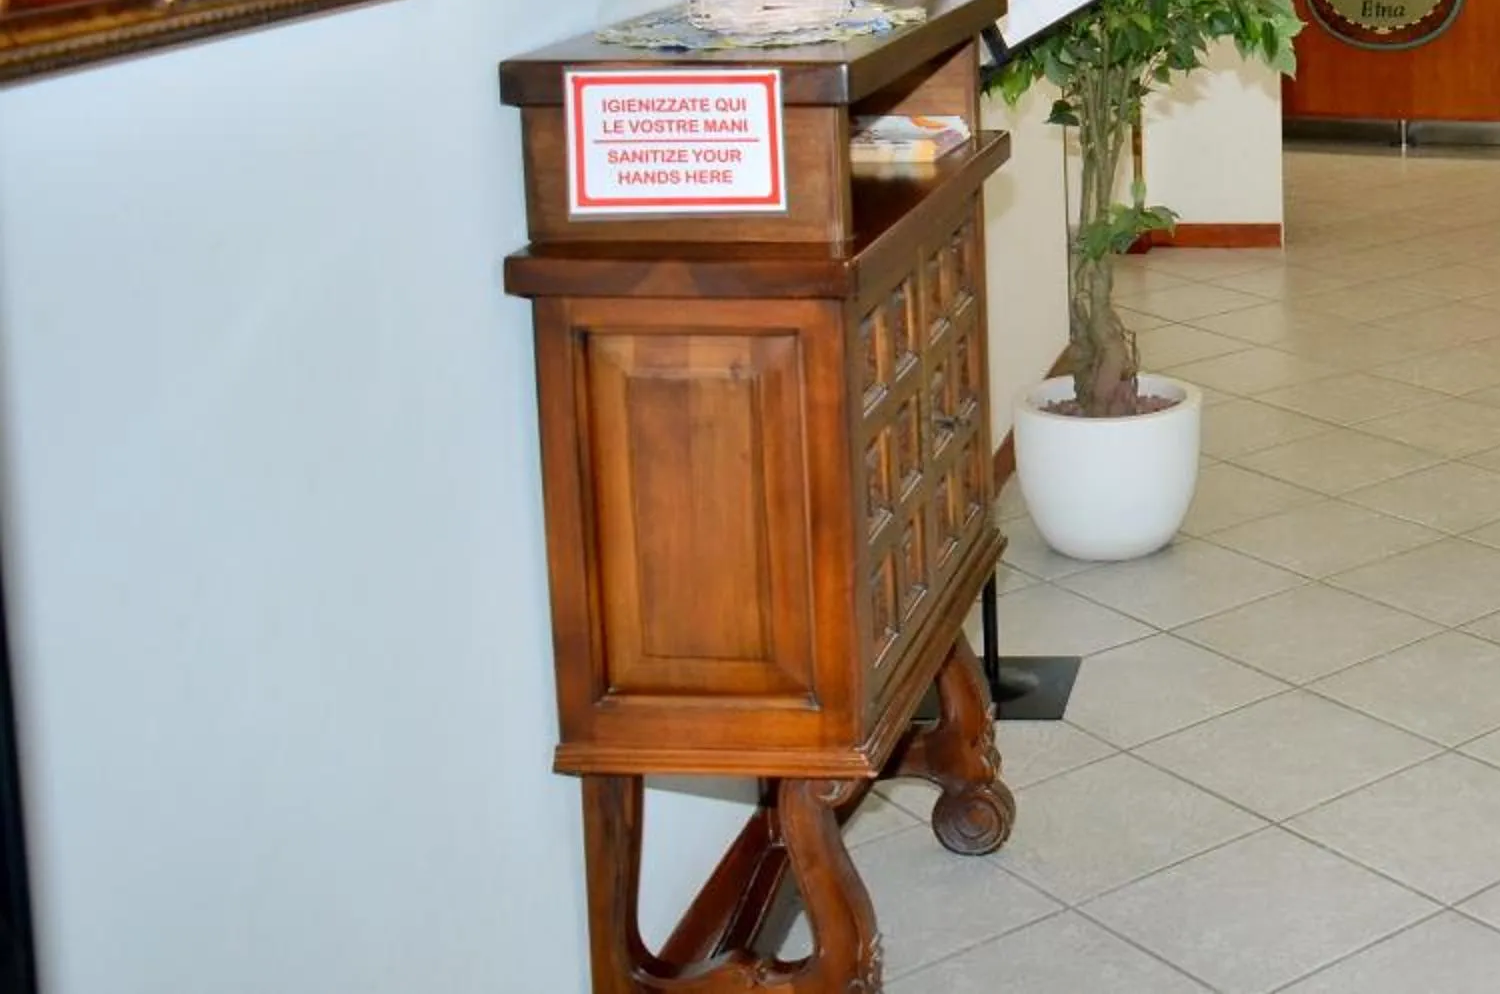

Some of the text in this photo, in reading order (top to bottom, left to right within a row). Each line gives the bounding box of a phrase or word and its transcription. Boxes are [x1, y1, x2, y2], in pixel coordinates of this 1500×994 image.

[1361, 0, 1406, 17] Etna
[602, 97, 747, 113] IGIENIZZATE QUI
[603, 118, 748, 134] LE VOSTRE MANI
[607, 149, 742, 164] SANITIZE YOUR
[617, 169, 733, 185] HANDS HERE
